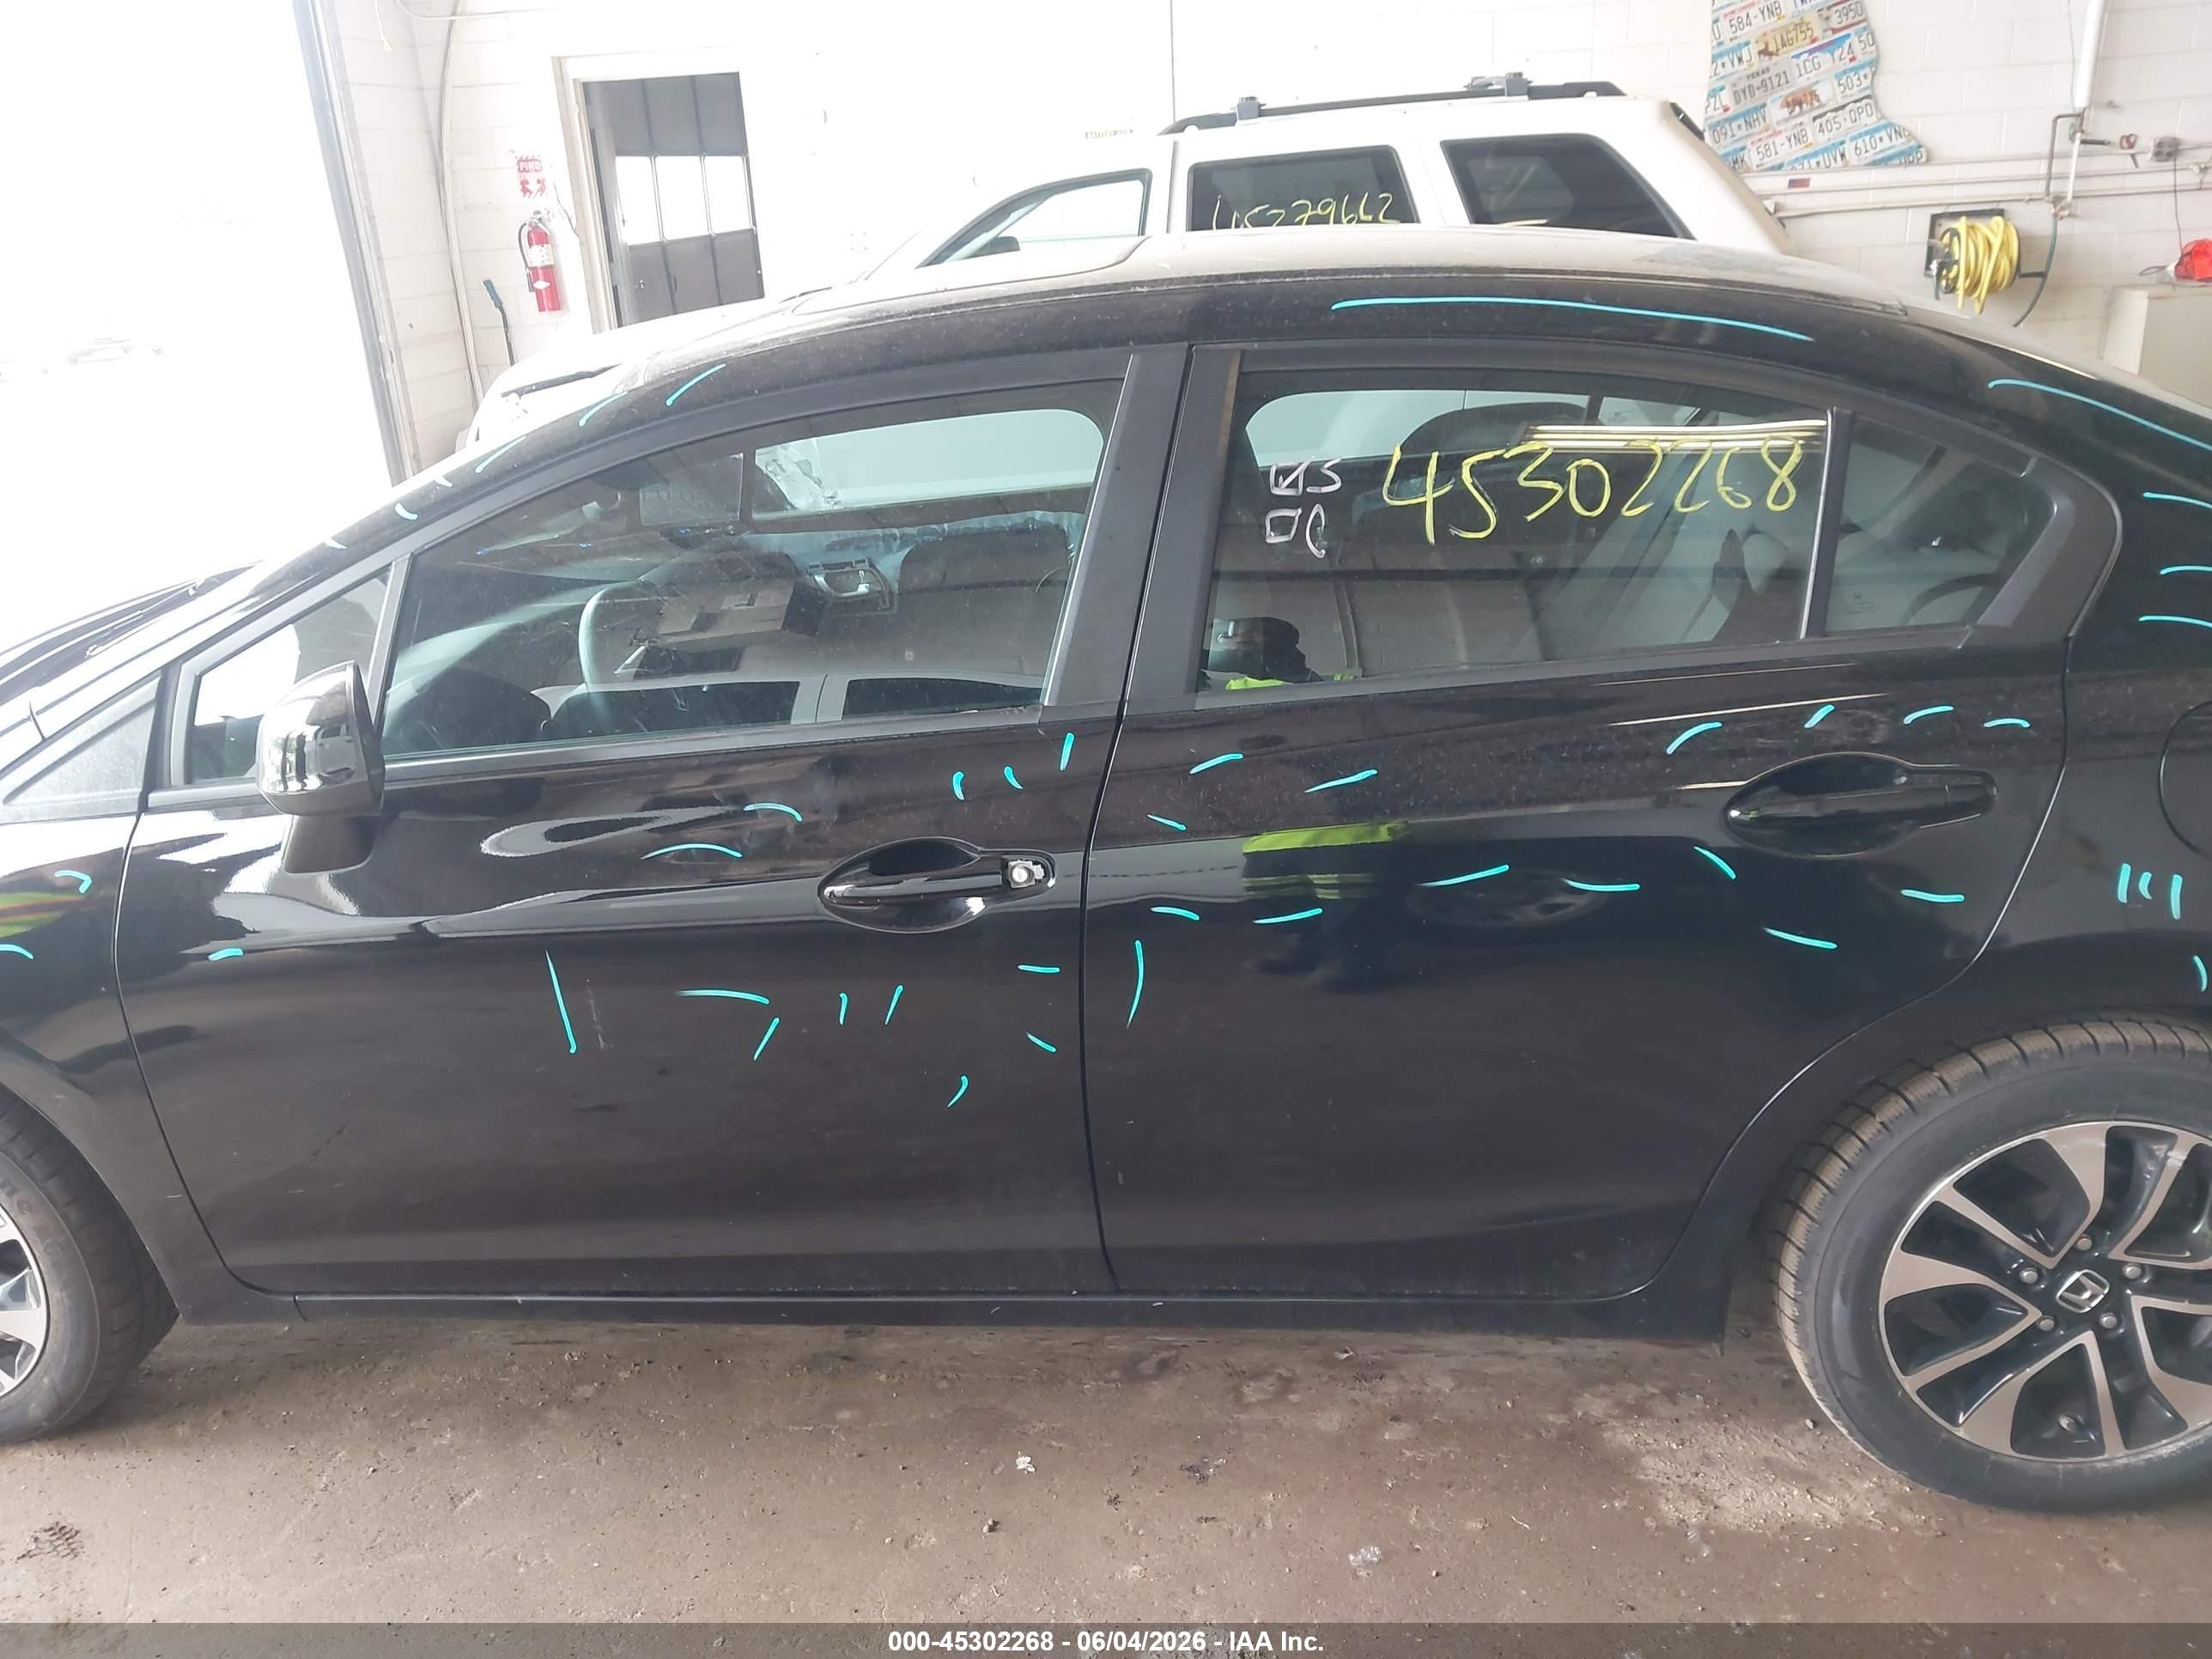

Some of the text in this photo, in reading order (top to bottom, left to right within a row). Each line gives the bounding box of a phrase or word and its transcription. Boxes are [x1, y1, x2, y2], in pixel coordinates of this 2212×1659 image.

[1729, 3, 1784, 35] 584-YNB
[1756, 129, 1809, 161] 581-YNB
[519, 161, 541, 172] FIRE
[1382, 434, 1803, 545] 45302268
